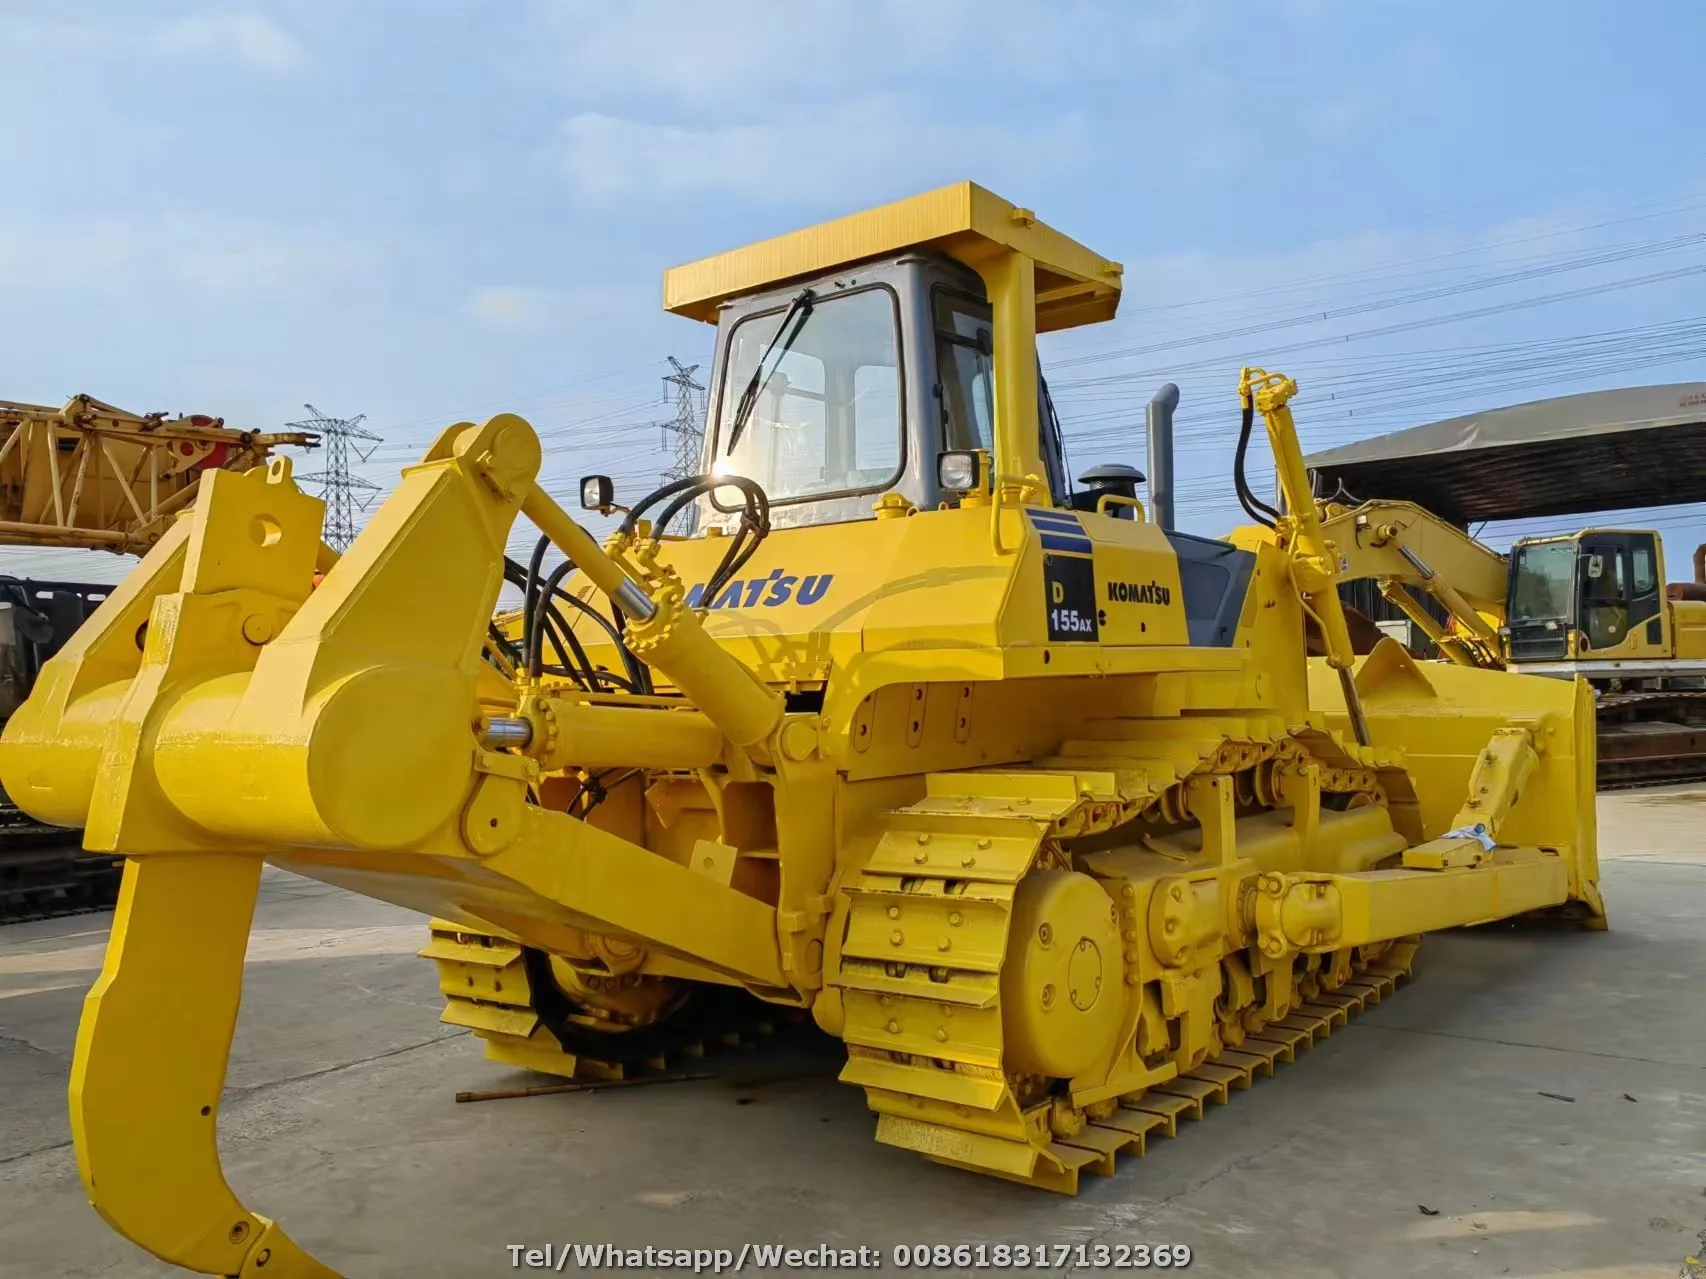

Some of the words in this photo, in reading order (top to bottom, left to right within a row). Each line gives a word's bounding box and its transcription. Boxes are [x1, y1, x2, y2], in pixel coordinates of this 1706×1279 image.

[683, 568, 835, 609] MATSU
[1052, 581, 1064, 604] D
[1107, 580, 1171, 606] KOMATSU
[1051, 608, 1092, 632] 155AX
